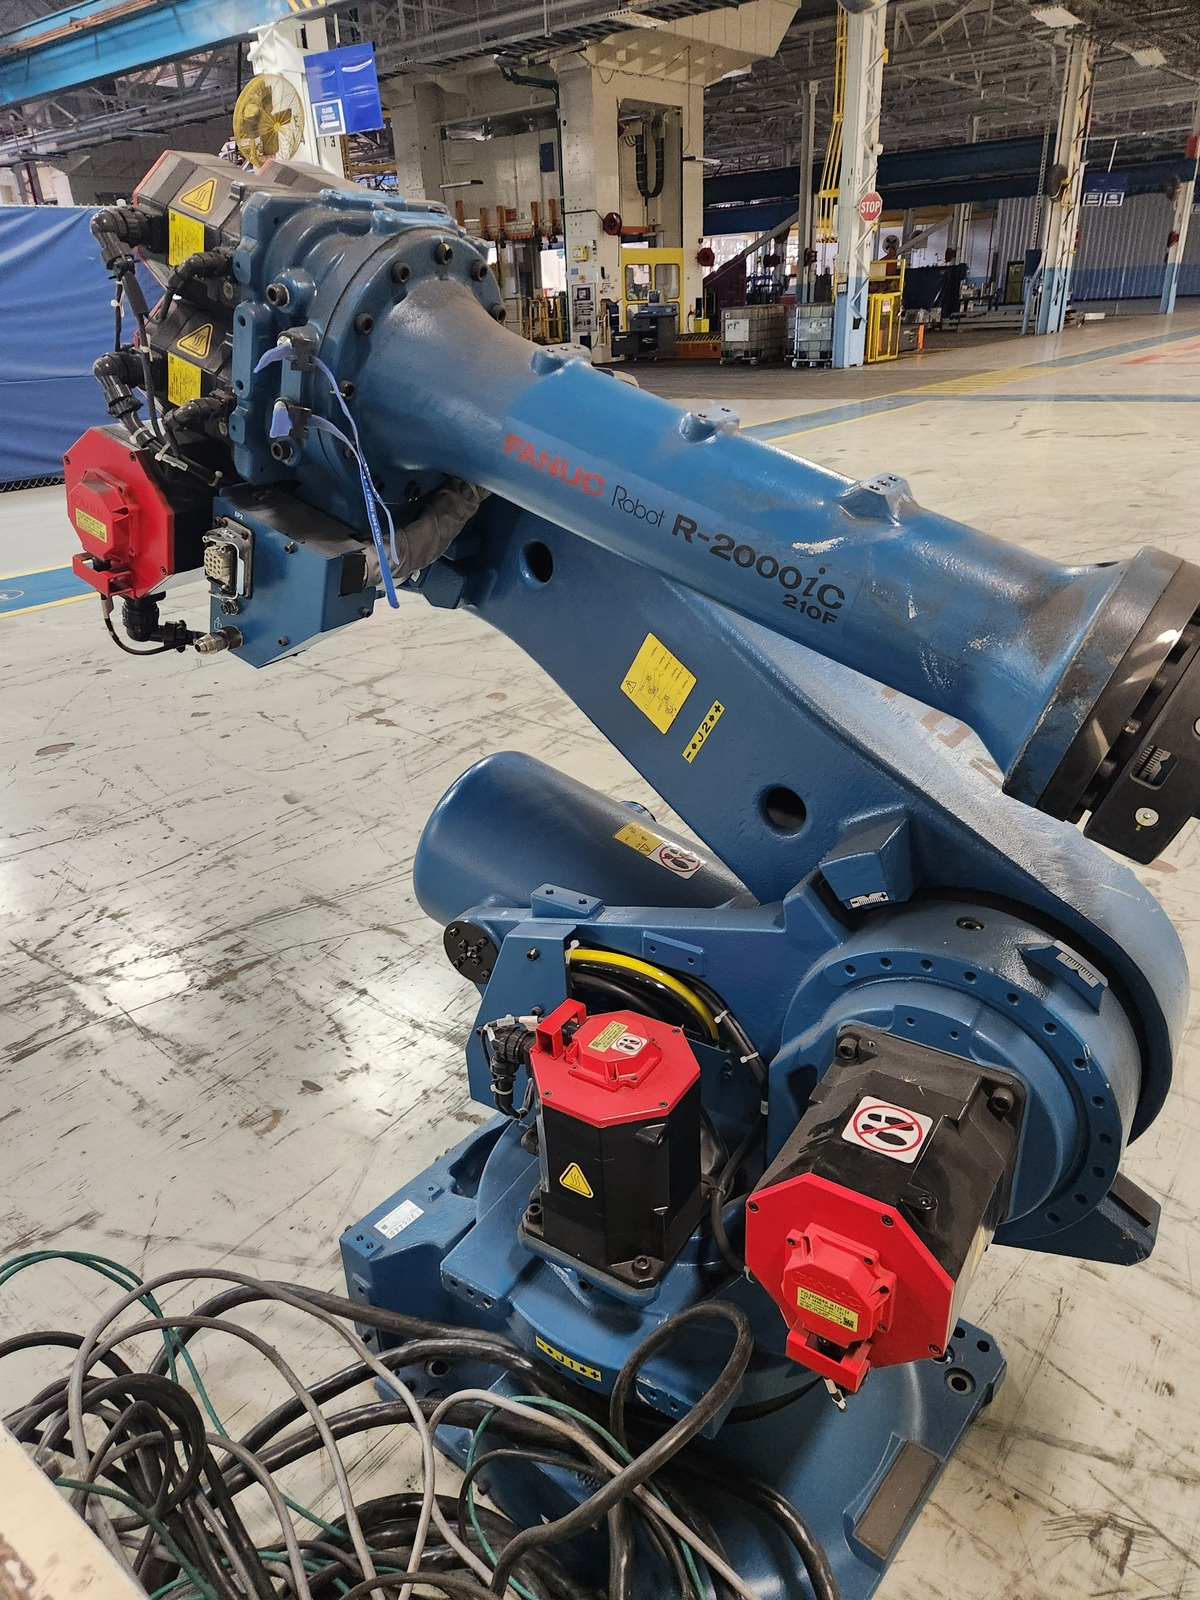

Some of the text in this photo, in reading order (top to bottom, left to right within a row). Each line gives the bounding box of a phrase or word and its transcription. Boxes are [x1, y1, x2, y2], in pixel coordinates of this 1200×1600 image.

[861, 201, 881, 213] STOP
[504, 433, 846, 610] FANUC Robot R-2000iC
[782, 593, 838, 625] 210F
[698, 723, 711, 743] J2
[556, 1355, 574, 1369] J1
